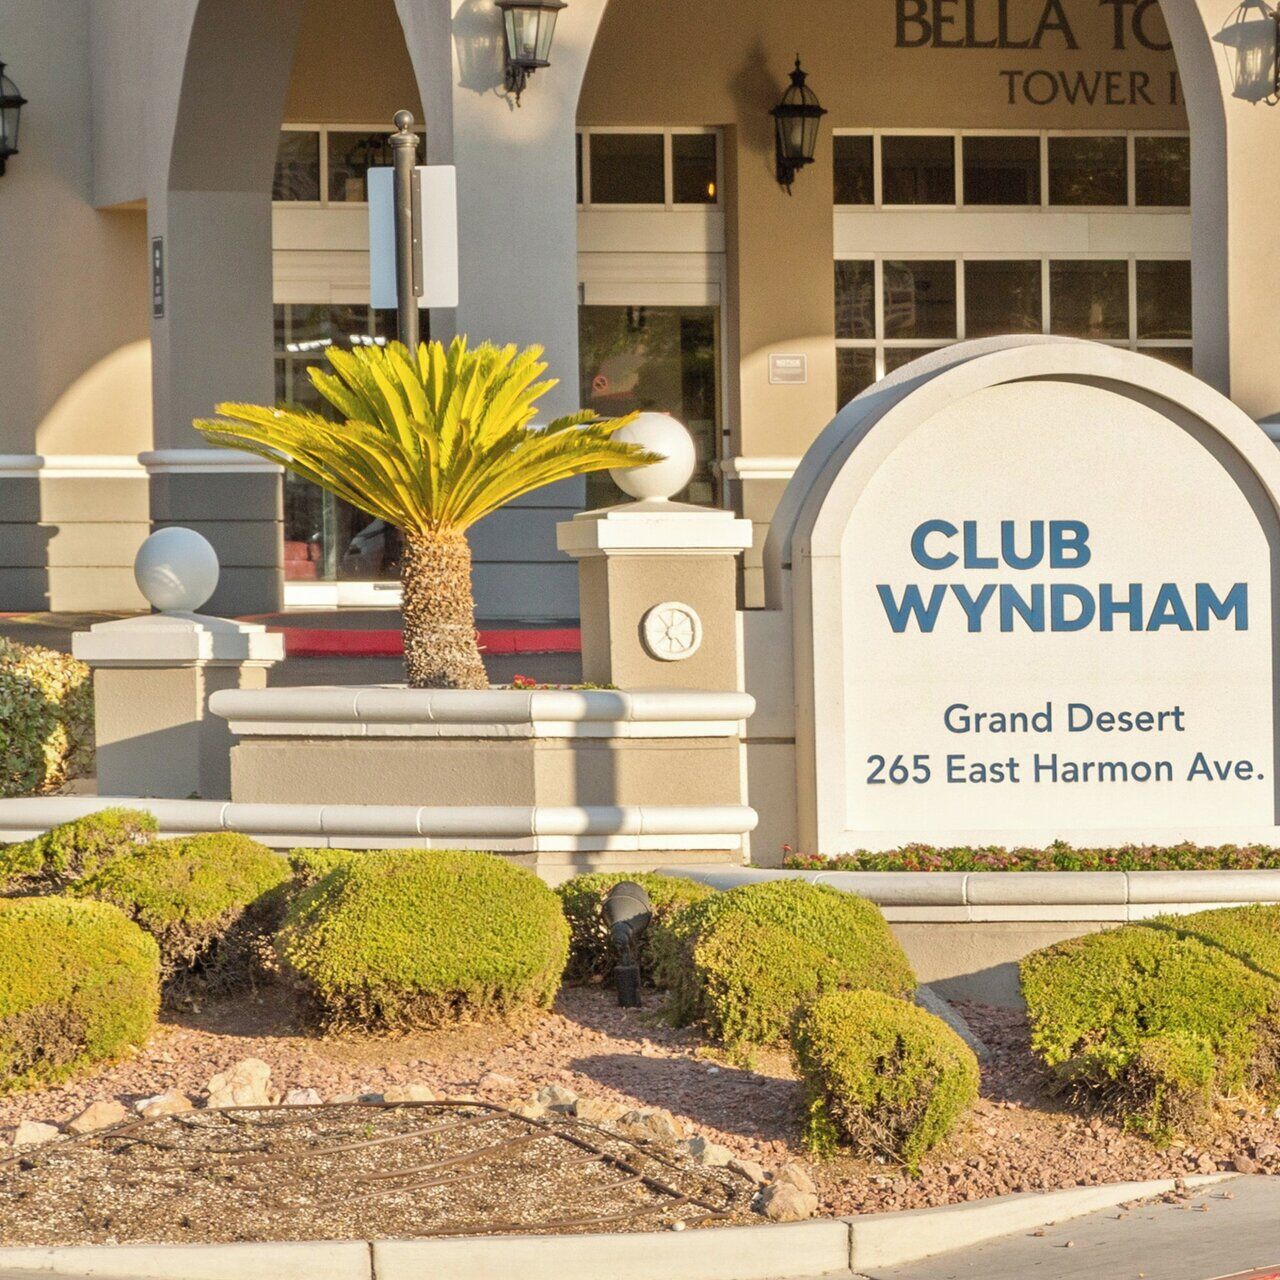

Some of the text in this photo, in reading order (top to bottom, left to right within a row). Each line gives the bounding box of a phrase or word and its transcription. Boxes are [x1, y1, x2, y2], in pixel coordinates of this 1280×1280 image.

[999, 70, 1156, 106] TOWER
[910, 519, 1092, 571] CLUB
[875, 582, 1249, 634] WYNDHAM
[943, 702, 1186, 734] Grand Desert
[866, 751, 1265, 785] 265 East Harmon Ave.
